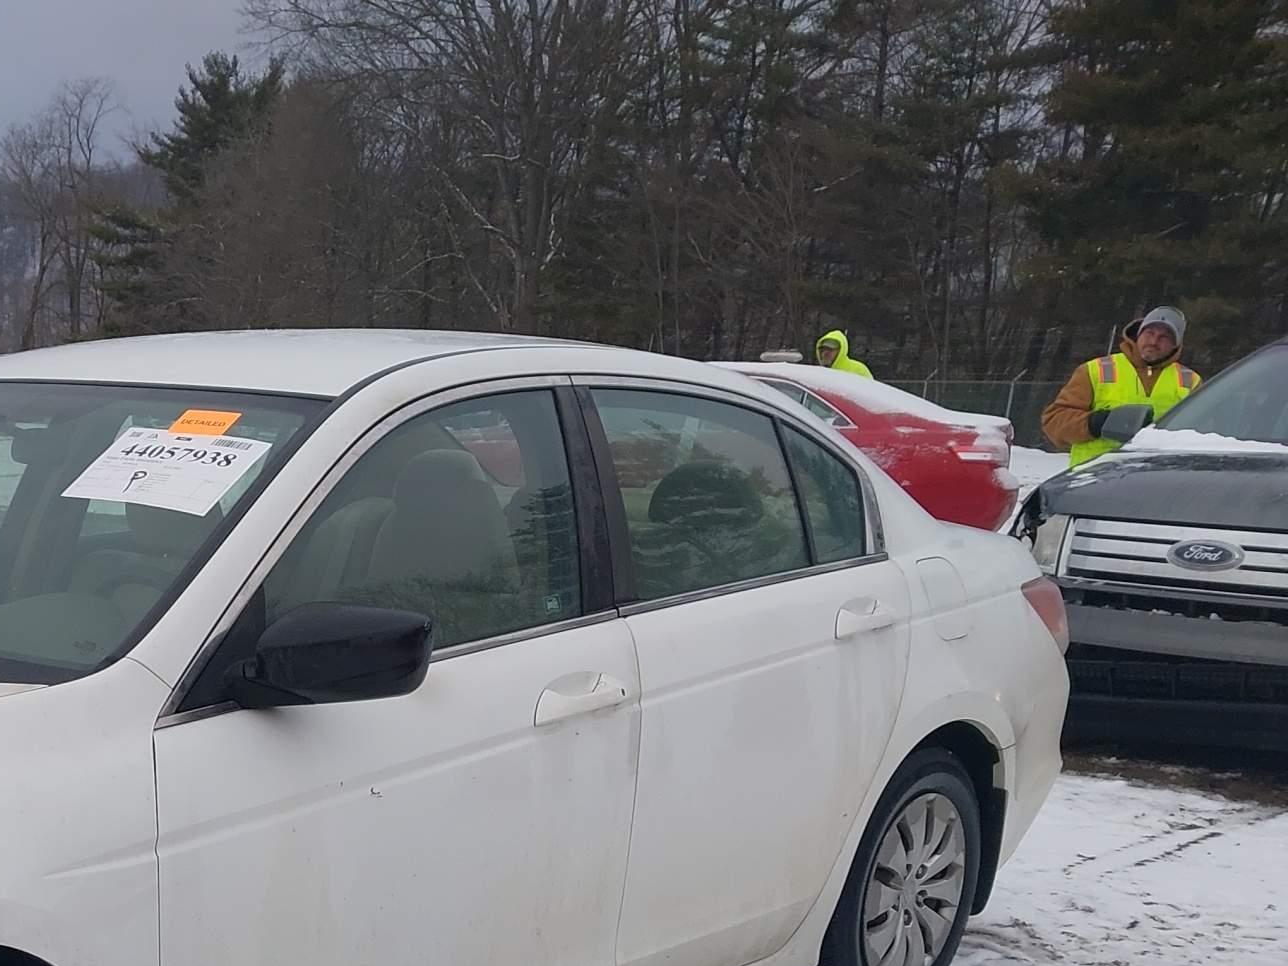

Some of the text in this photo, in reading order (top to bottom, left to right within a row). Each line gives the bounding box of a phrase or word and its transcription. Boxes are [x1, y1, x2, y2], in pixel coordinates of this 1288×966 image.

[180, 418, 226, 427] DETAILED
[121, 443, 238, 468] 44057938
[1183, 544, 1224, 561] Ford
